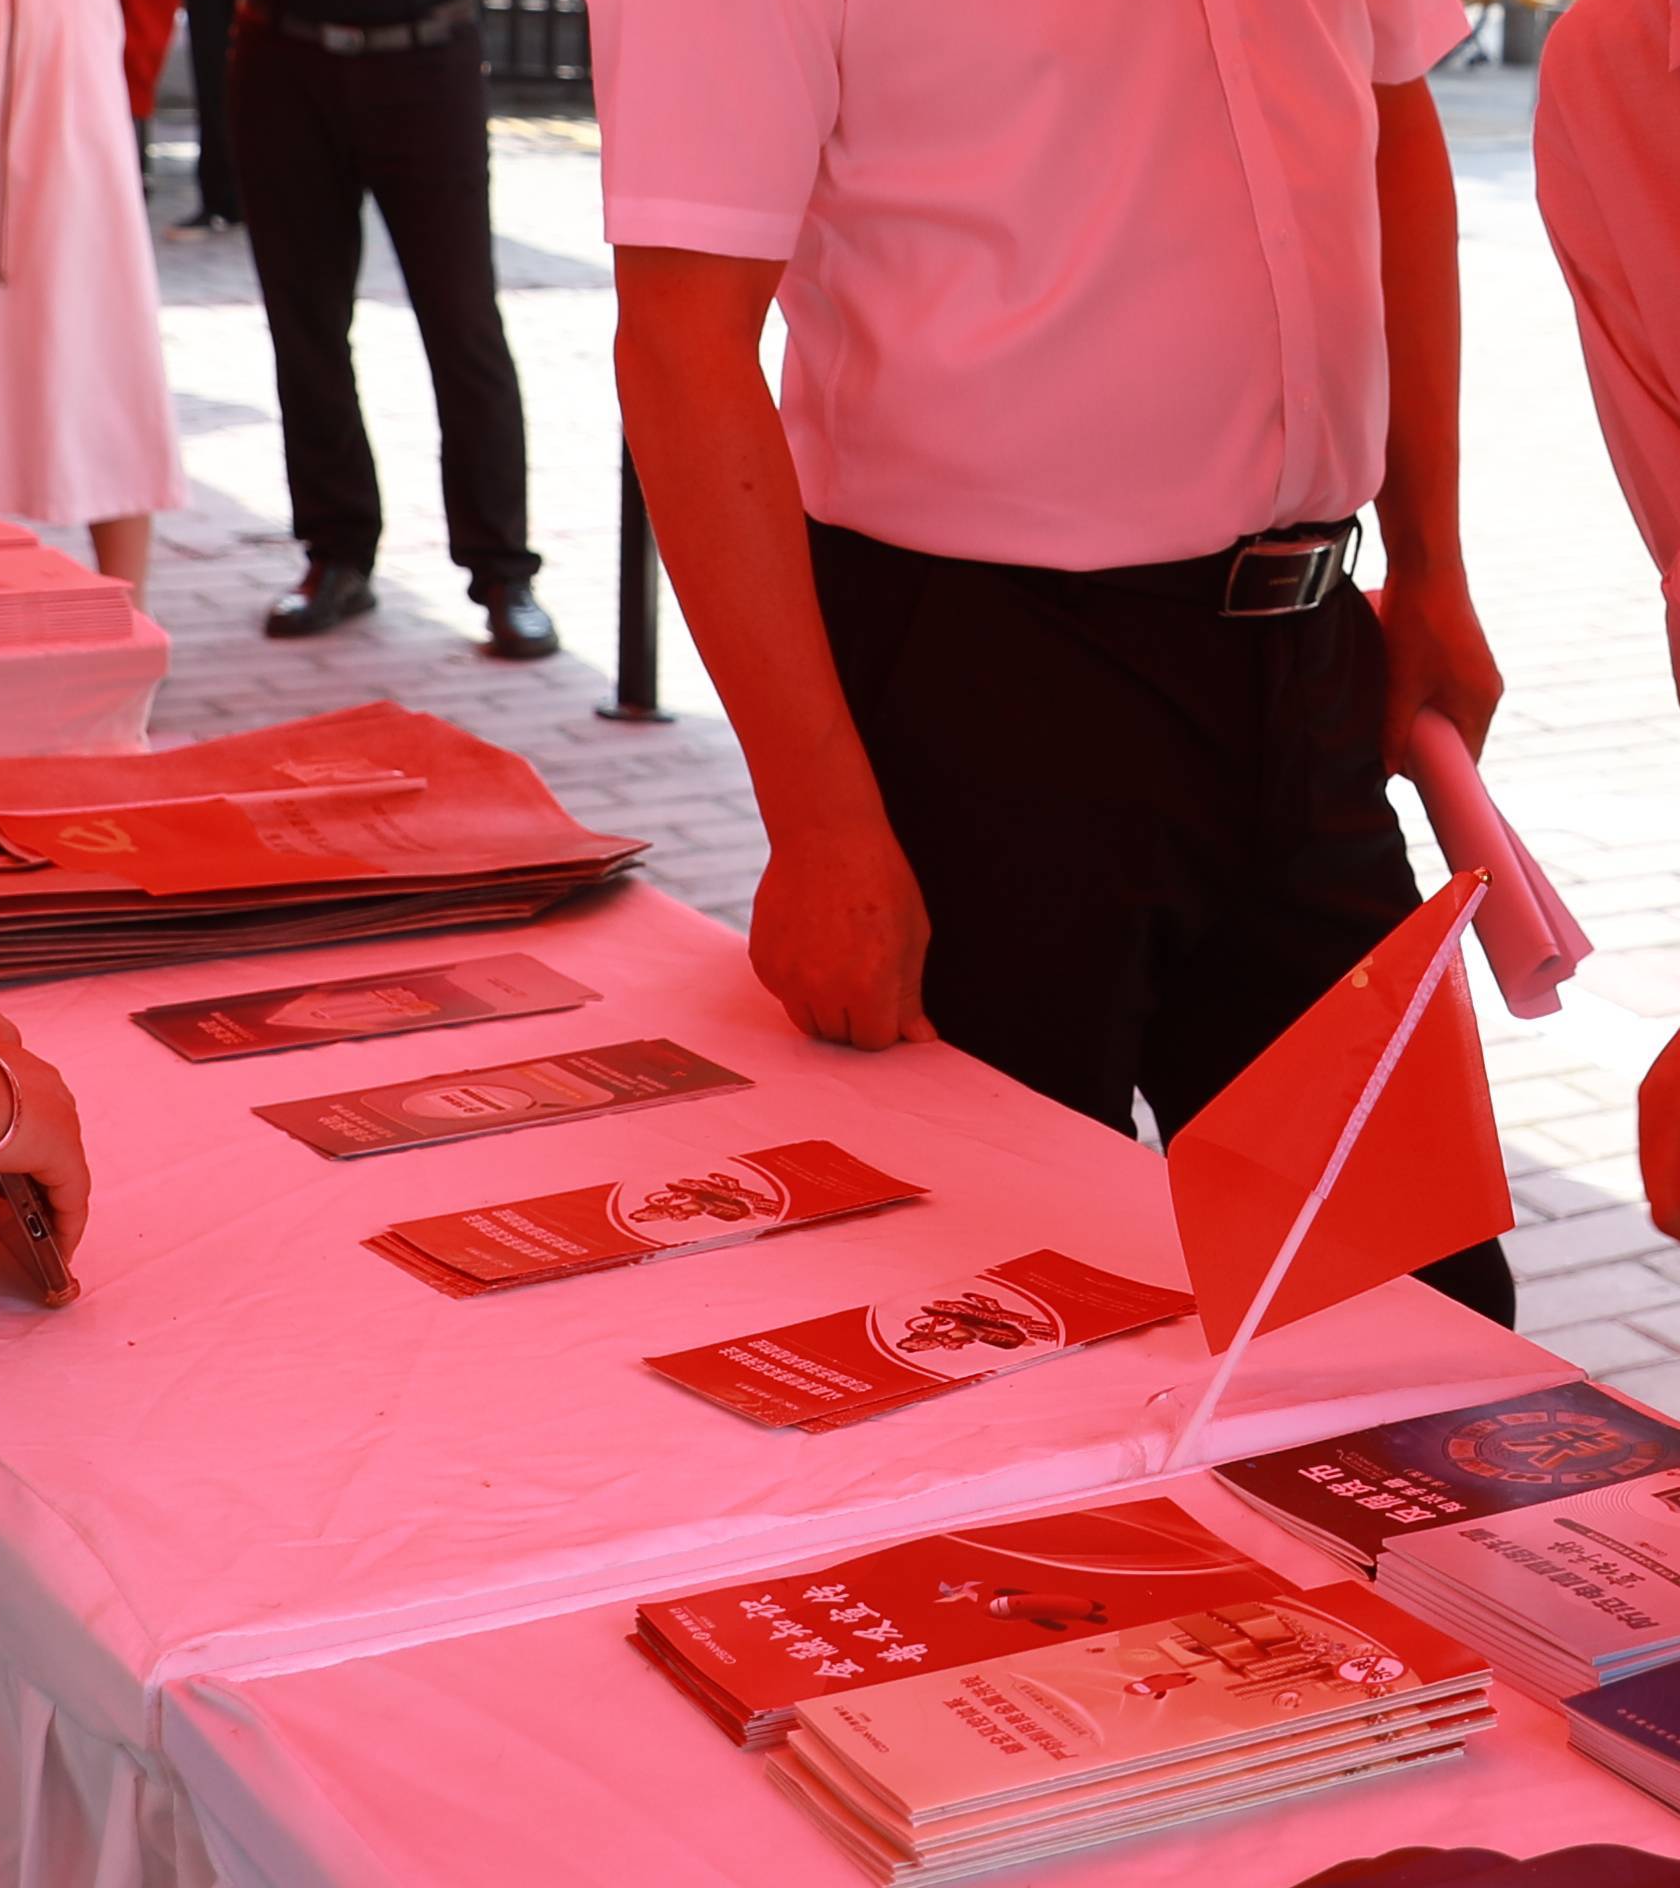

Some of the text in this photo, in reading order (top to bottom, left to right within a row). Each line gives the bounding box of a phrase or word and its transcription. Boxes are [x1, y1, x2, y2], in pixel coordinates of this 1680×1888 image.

[1298, 1465, 1437, 1523] 反假货币
[1382, 1478, 1467, 1513] 知识手册
[1458, 1528, 1660, 1630] 防范电信网络诈骗
[1547, 1541, 1646, 1588] 宣传手册
[739, 1594, 864, 1678] 金融知识
[803, 1583, 928, 1662] 普及宣传
